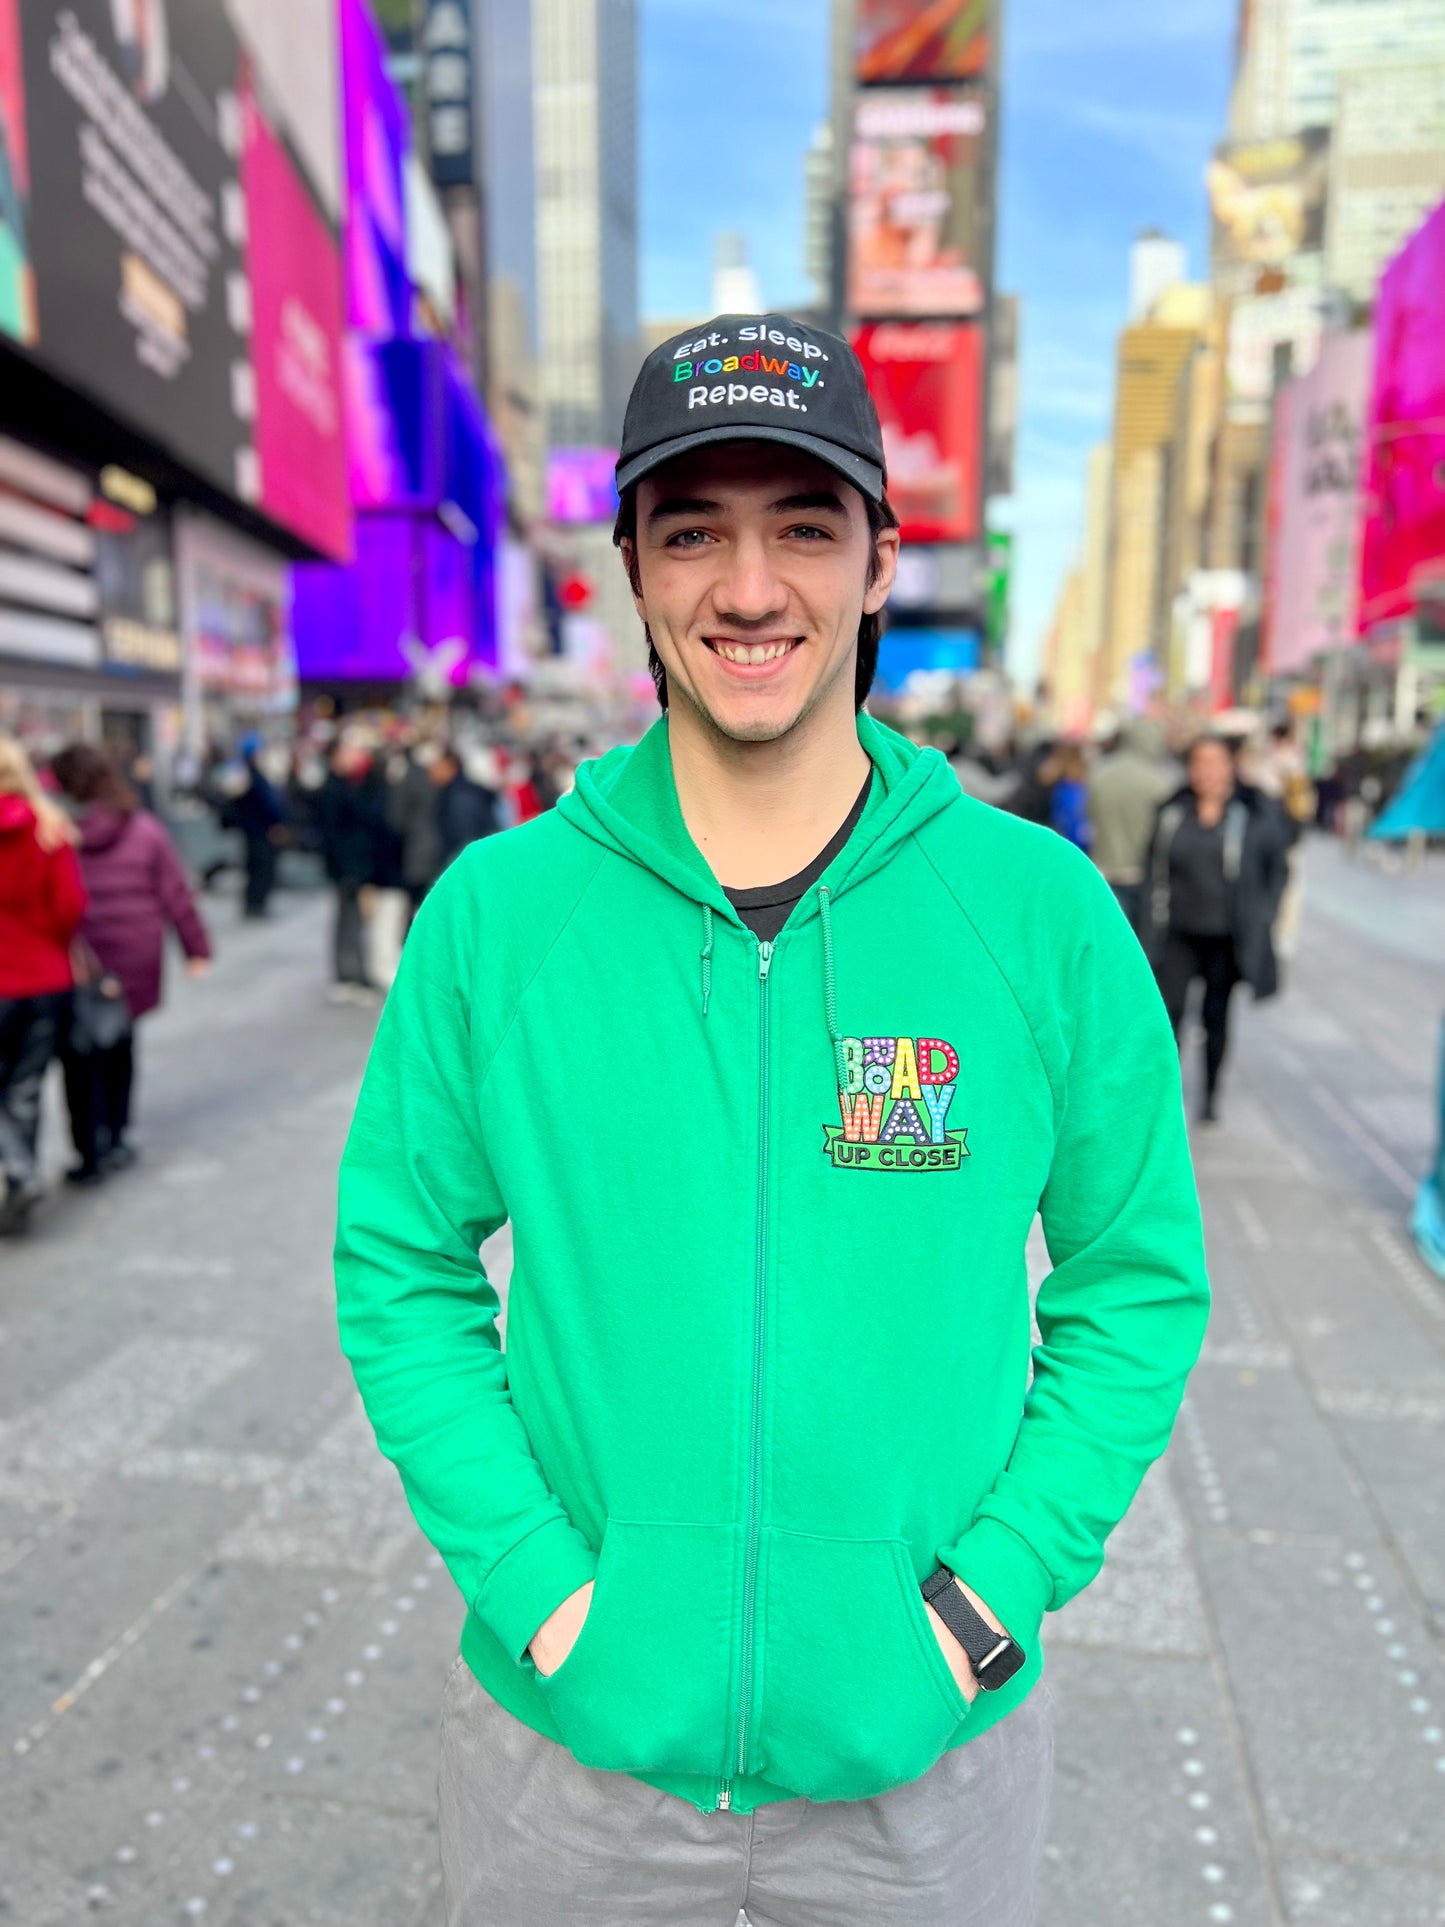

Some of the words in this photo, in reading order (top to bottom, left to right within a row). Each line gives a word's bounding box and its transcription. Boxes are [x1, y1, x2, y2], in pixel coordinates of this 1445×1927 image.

[673, 332, 728, 360] Eat.
[738, 324, 829, 361] Sleep.
[673, 349, 825, 388] Broadway.
[688, 383, 808, 412] Repeat.
[837, 1144, 871, 1165] UP
[878, 1148, 957, 1167] CLOSE
